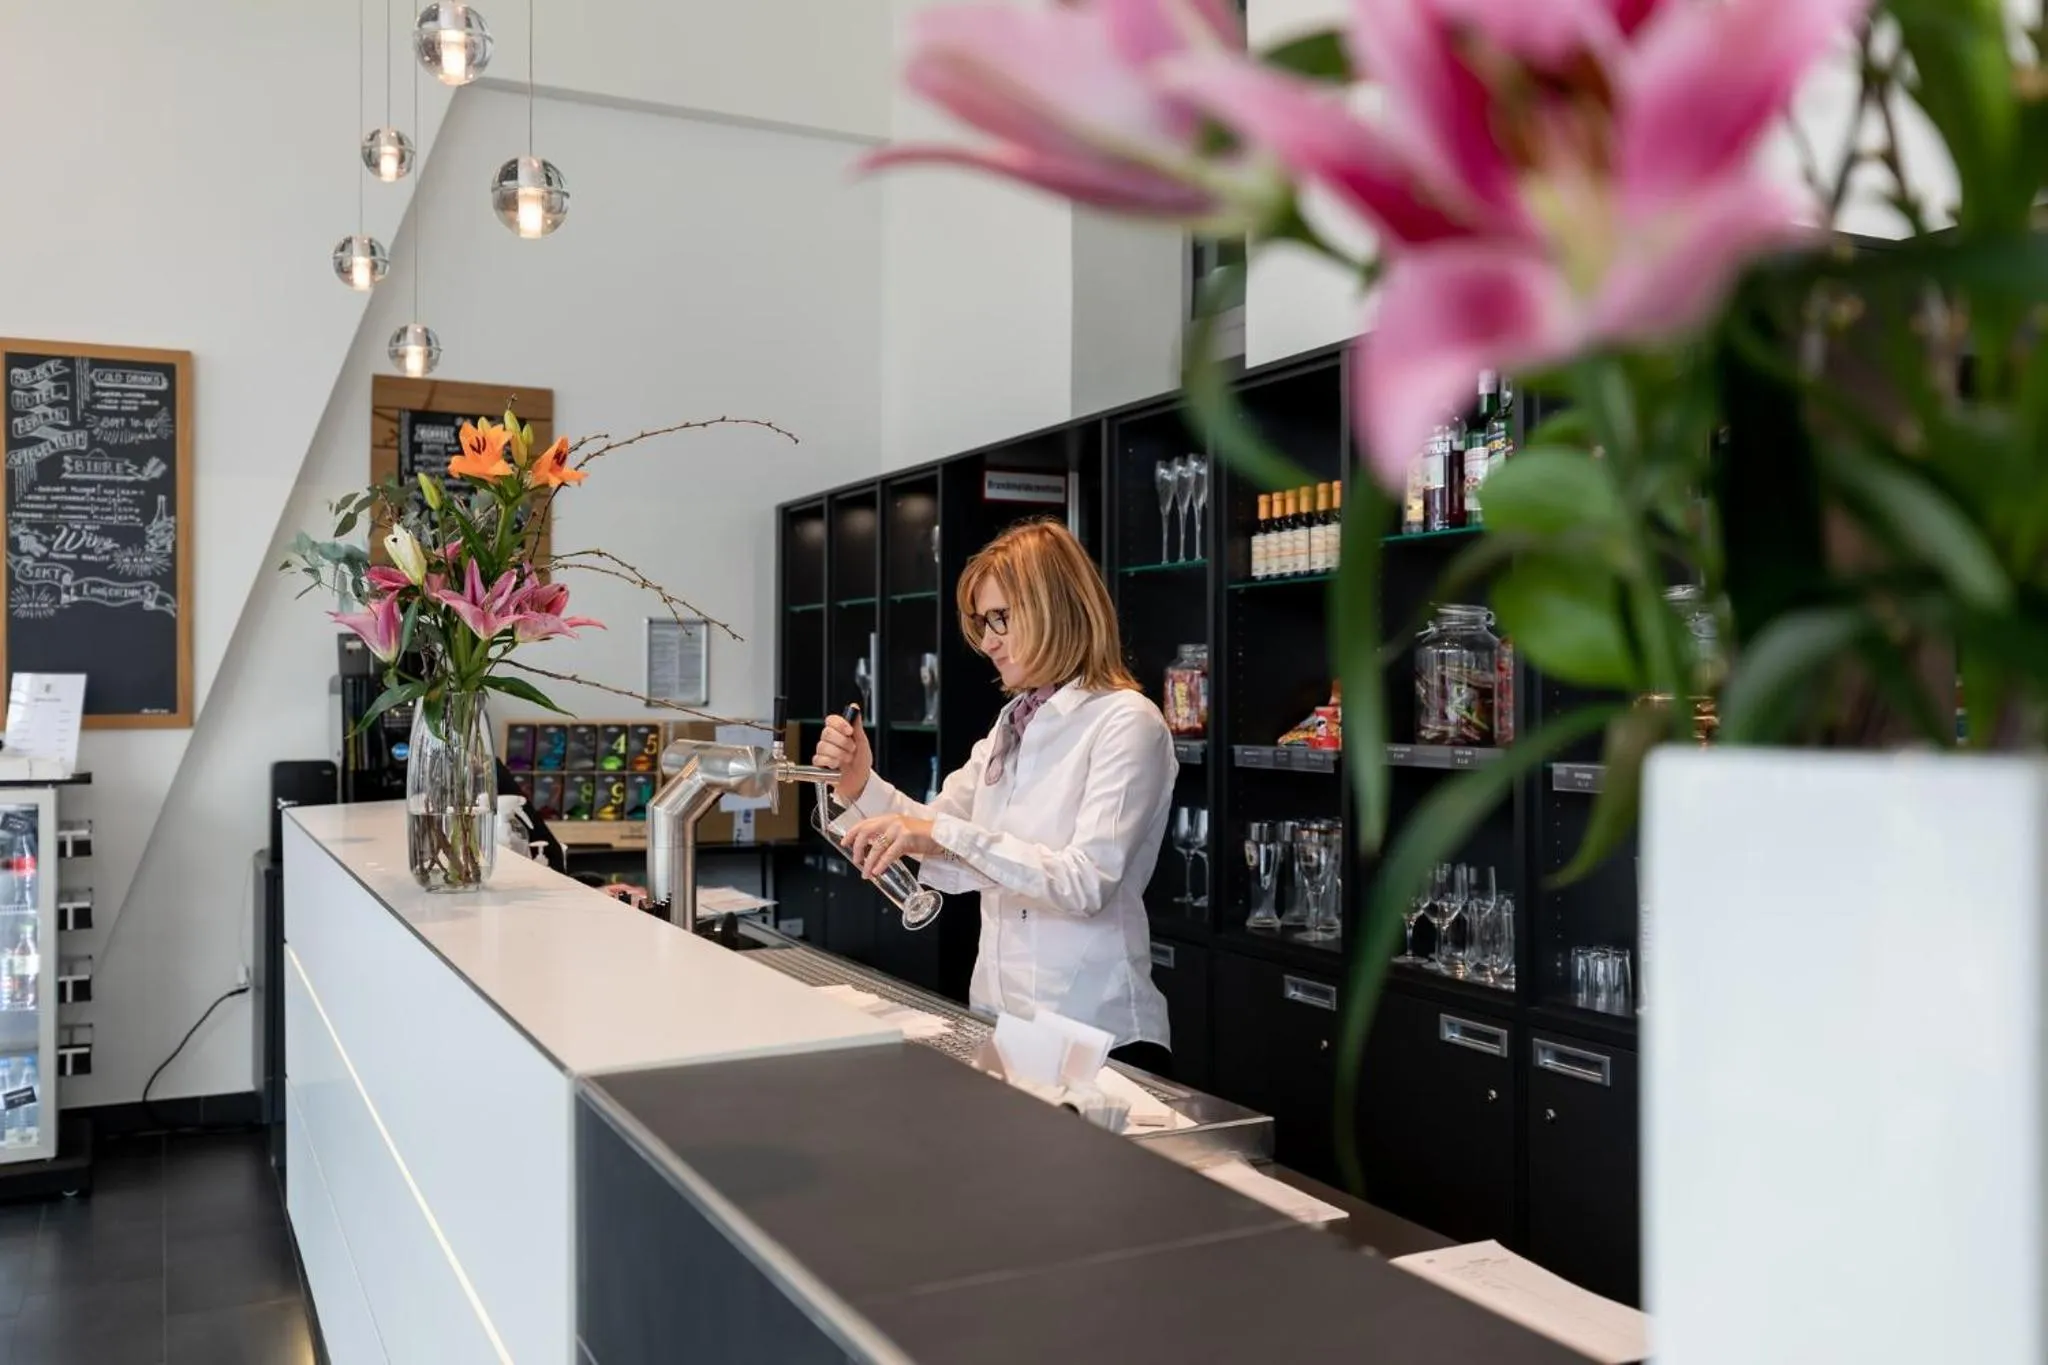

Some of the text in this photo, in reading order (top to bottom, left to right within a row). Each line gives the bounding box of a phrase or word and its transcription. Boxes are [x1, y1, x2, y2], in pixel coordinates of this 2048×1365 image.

[97, 372, 161, 385] COLD DRINKS
[15, 386, 63, 409] HOTEL
[17, 408, 66, 434] BERLIN
[74, 459, 125, 473] BIERE
[53, 524, 120, 554] Wine
[23, 564, 62, 579] SEKT
[612, 733, 626, 754] 4
[644, 733, 658, 755] 5
[580, 782, 593, 803] 8
[611, 782, 624, 804] 9
